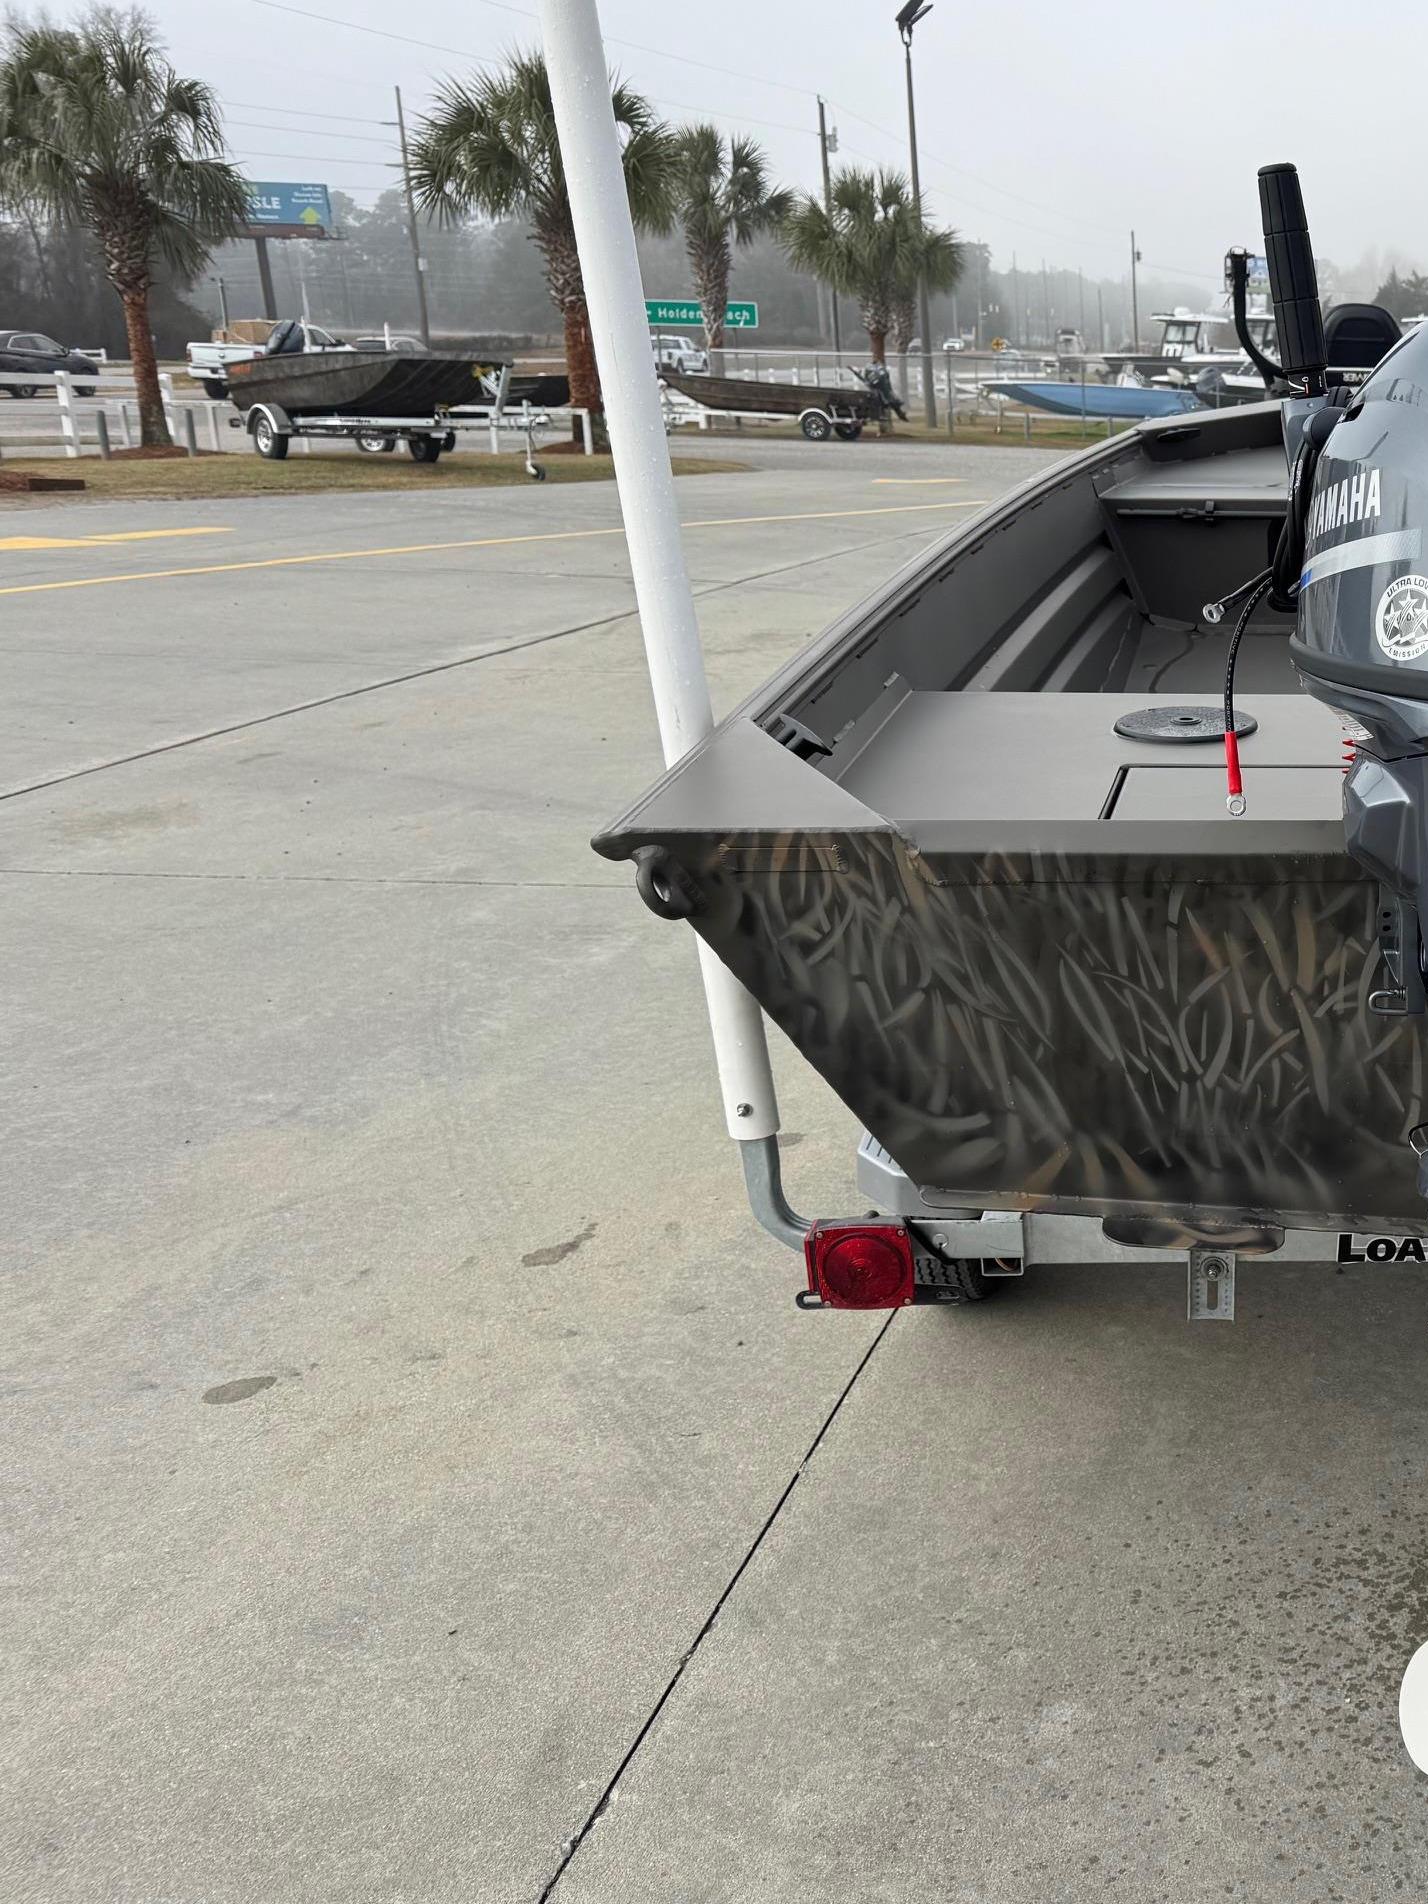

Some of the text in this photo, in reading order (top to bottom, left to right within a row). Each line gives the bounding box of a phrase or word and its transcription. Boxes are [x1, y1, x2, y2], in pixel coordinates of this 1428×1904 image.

[1312, 469, 1381, 540] YAMAHA
[1387, 578, 1412, 598] ULTRA
[1388, 643, 1426, 658] EMISSION
